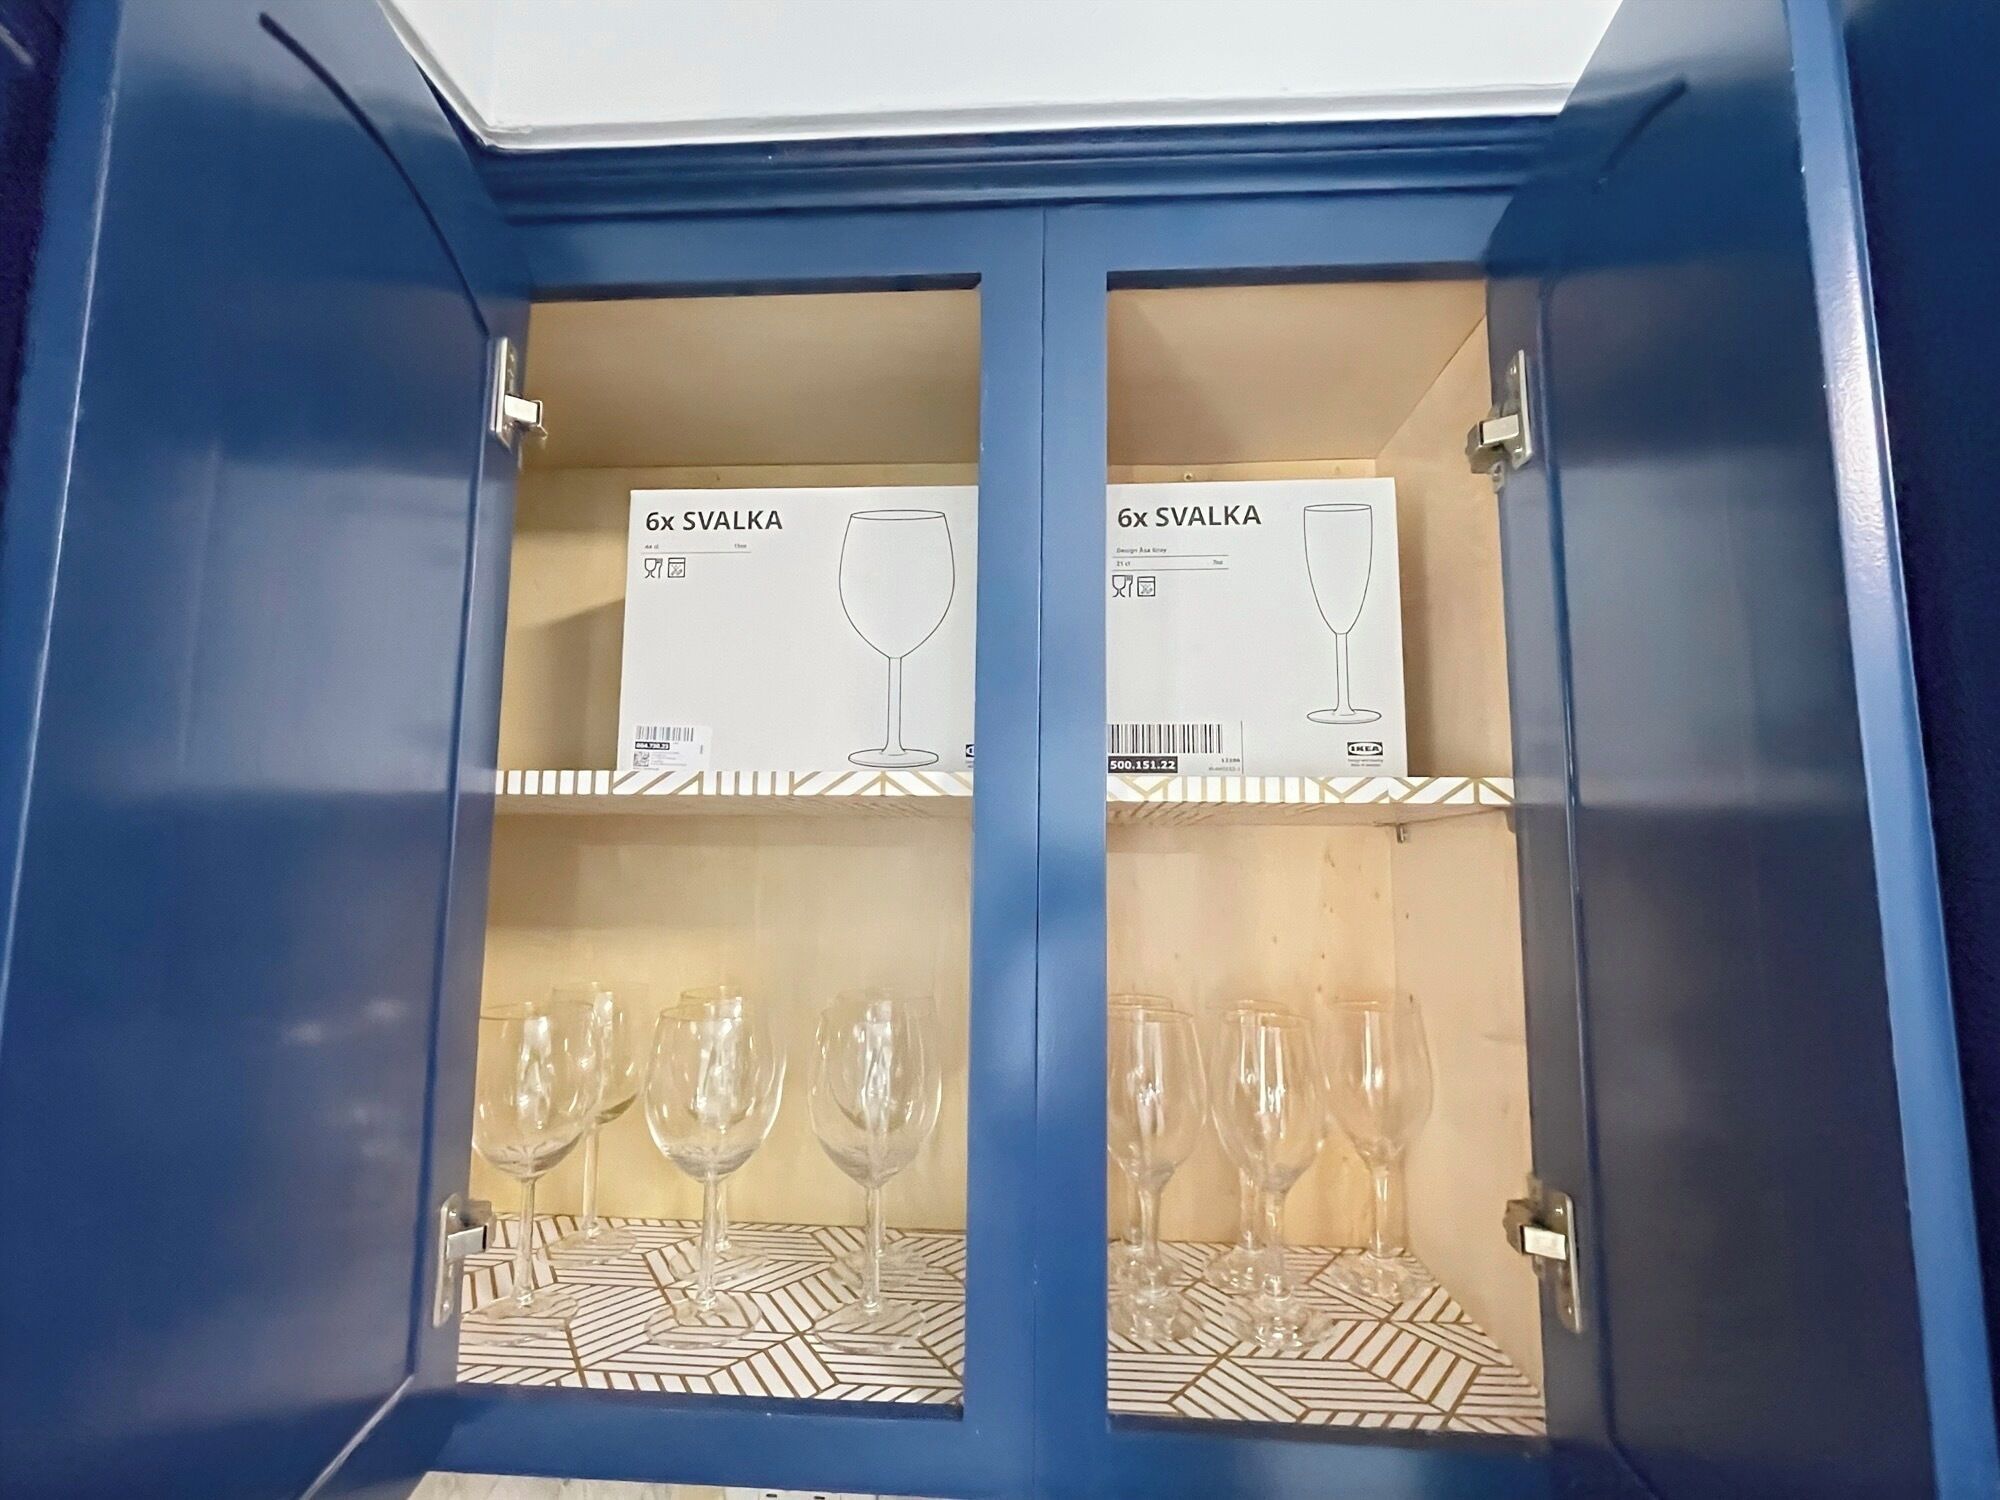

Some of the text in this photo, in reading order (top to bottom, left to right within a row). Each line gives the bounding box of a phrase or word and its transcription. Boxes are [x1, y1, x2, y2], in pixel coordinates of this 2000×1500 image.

[645, 510, 784, 531] 6x SVALKA
[1117, 505, 1263, 528] 6x SVALKA
[1110, 760, 1176, 770] 500.151.22
